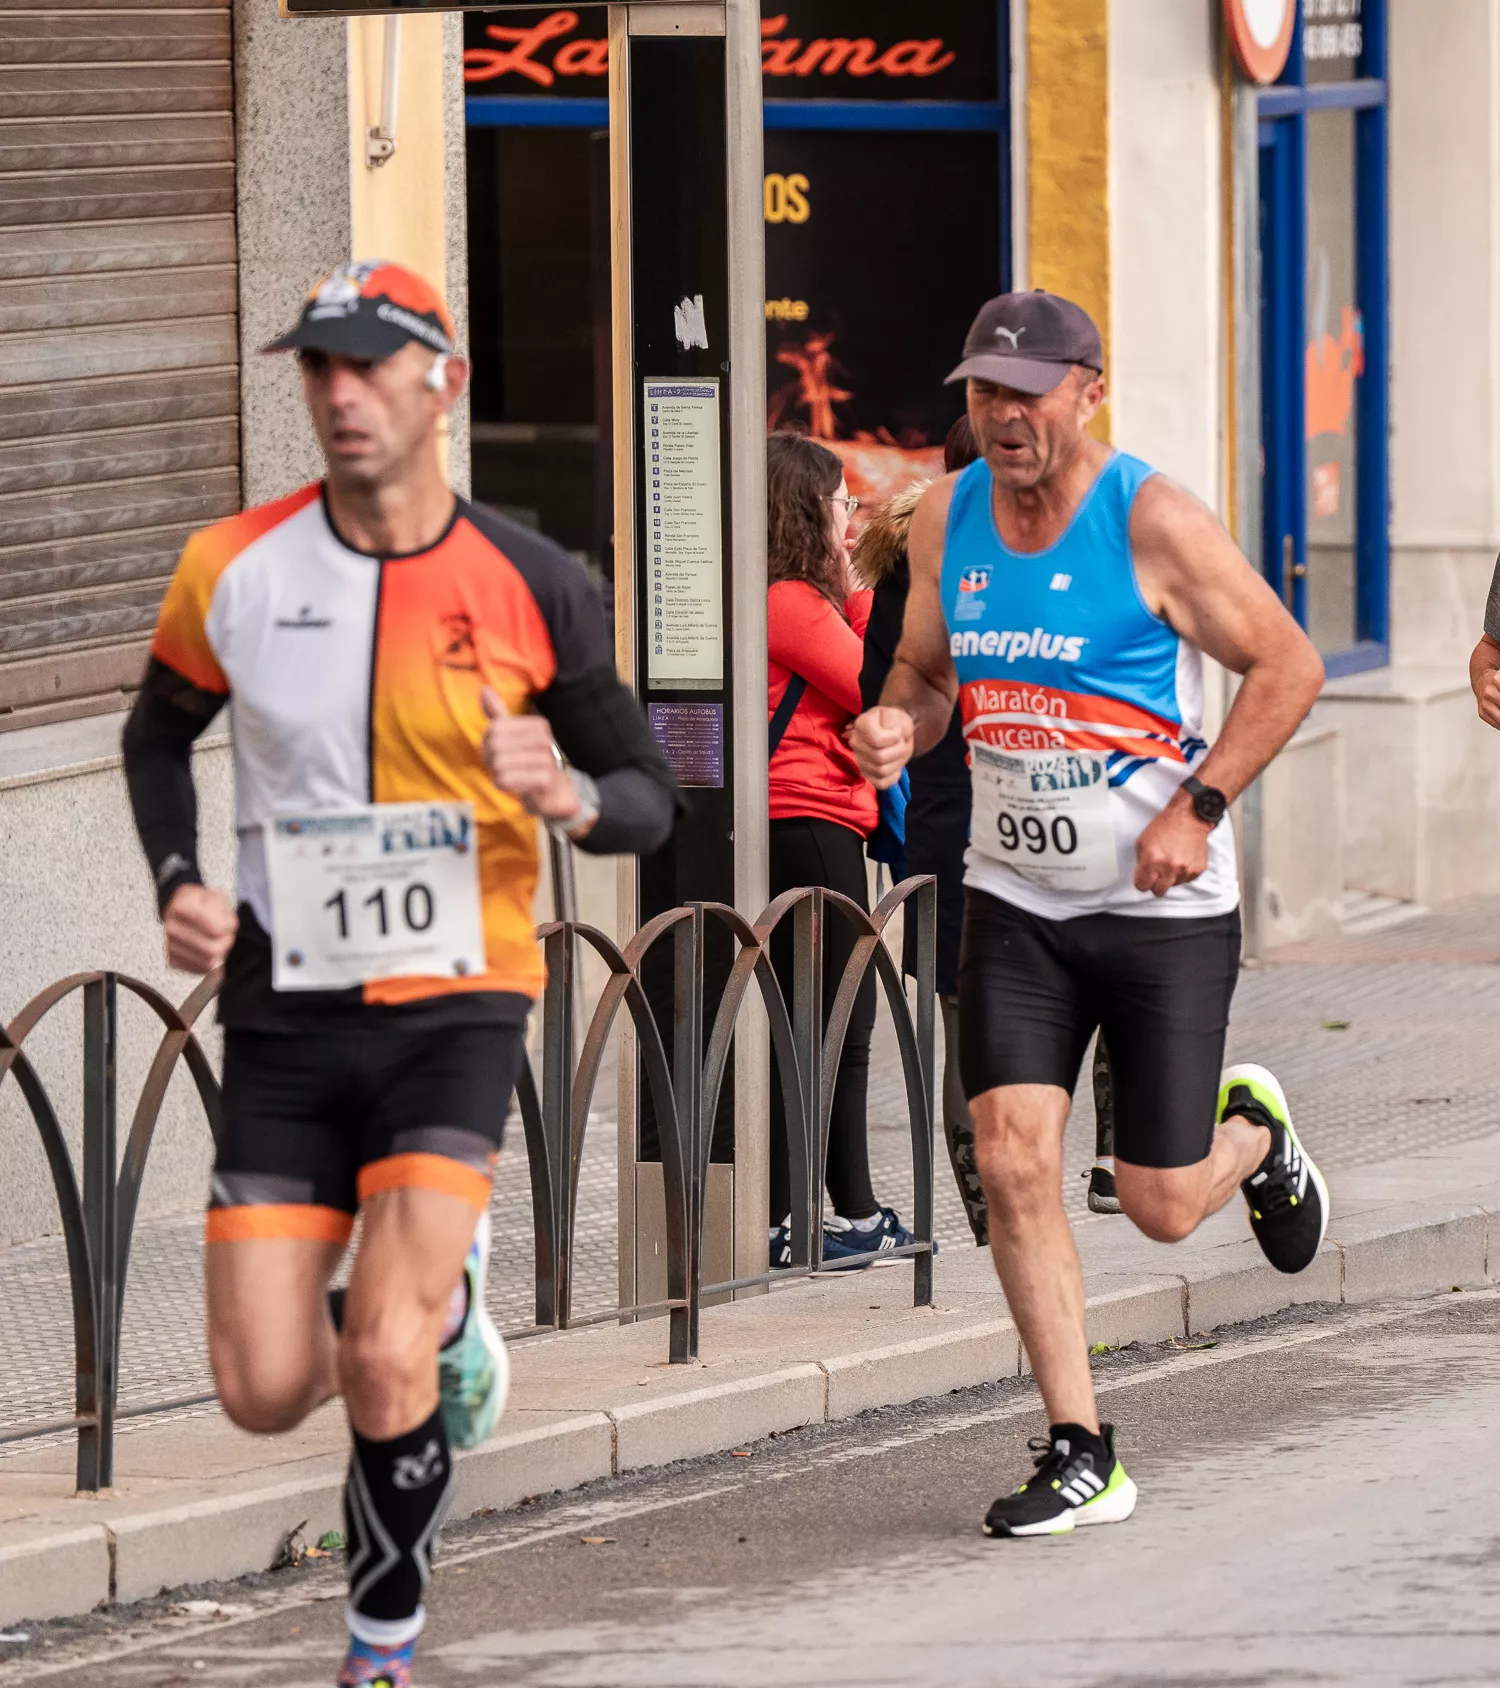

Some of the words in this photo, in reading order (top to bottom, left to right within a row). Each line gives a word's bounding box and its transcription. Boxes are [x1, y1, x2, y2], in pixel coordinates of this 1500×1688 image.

[463, 10, 608, 86] La
[762, 14, 955, 77] ama
[764, 173, 810, 224] OS
[950, 627, 1084, 664] enerplus
[971, 684, 1067, 718] Maratón
[997, 811, 1077, 855] 990
[324, 882, 434, 938] 110
